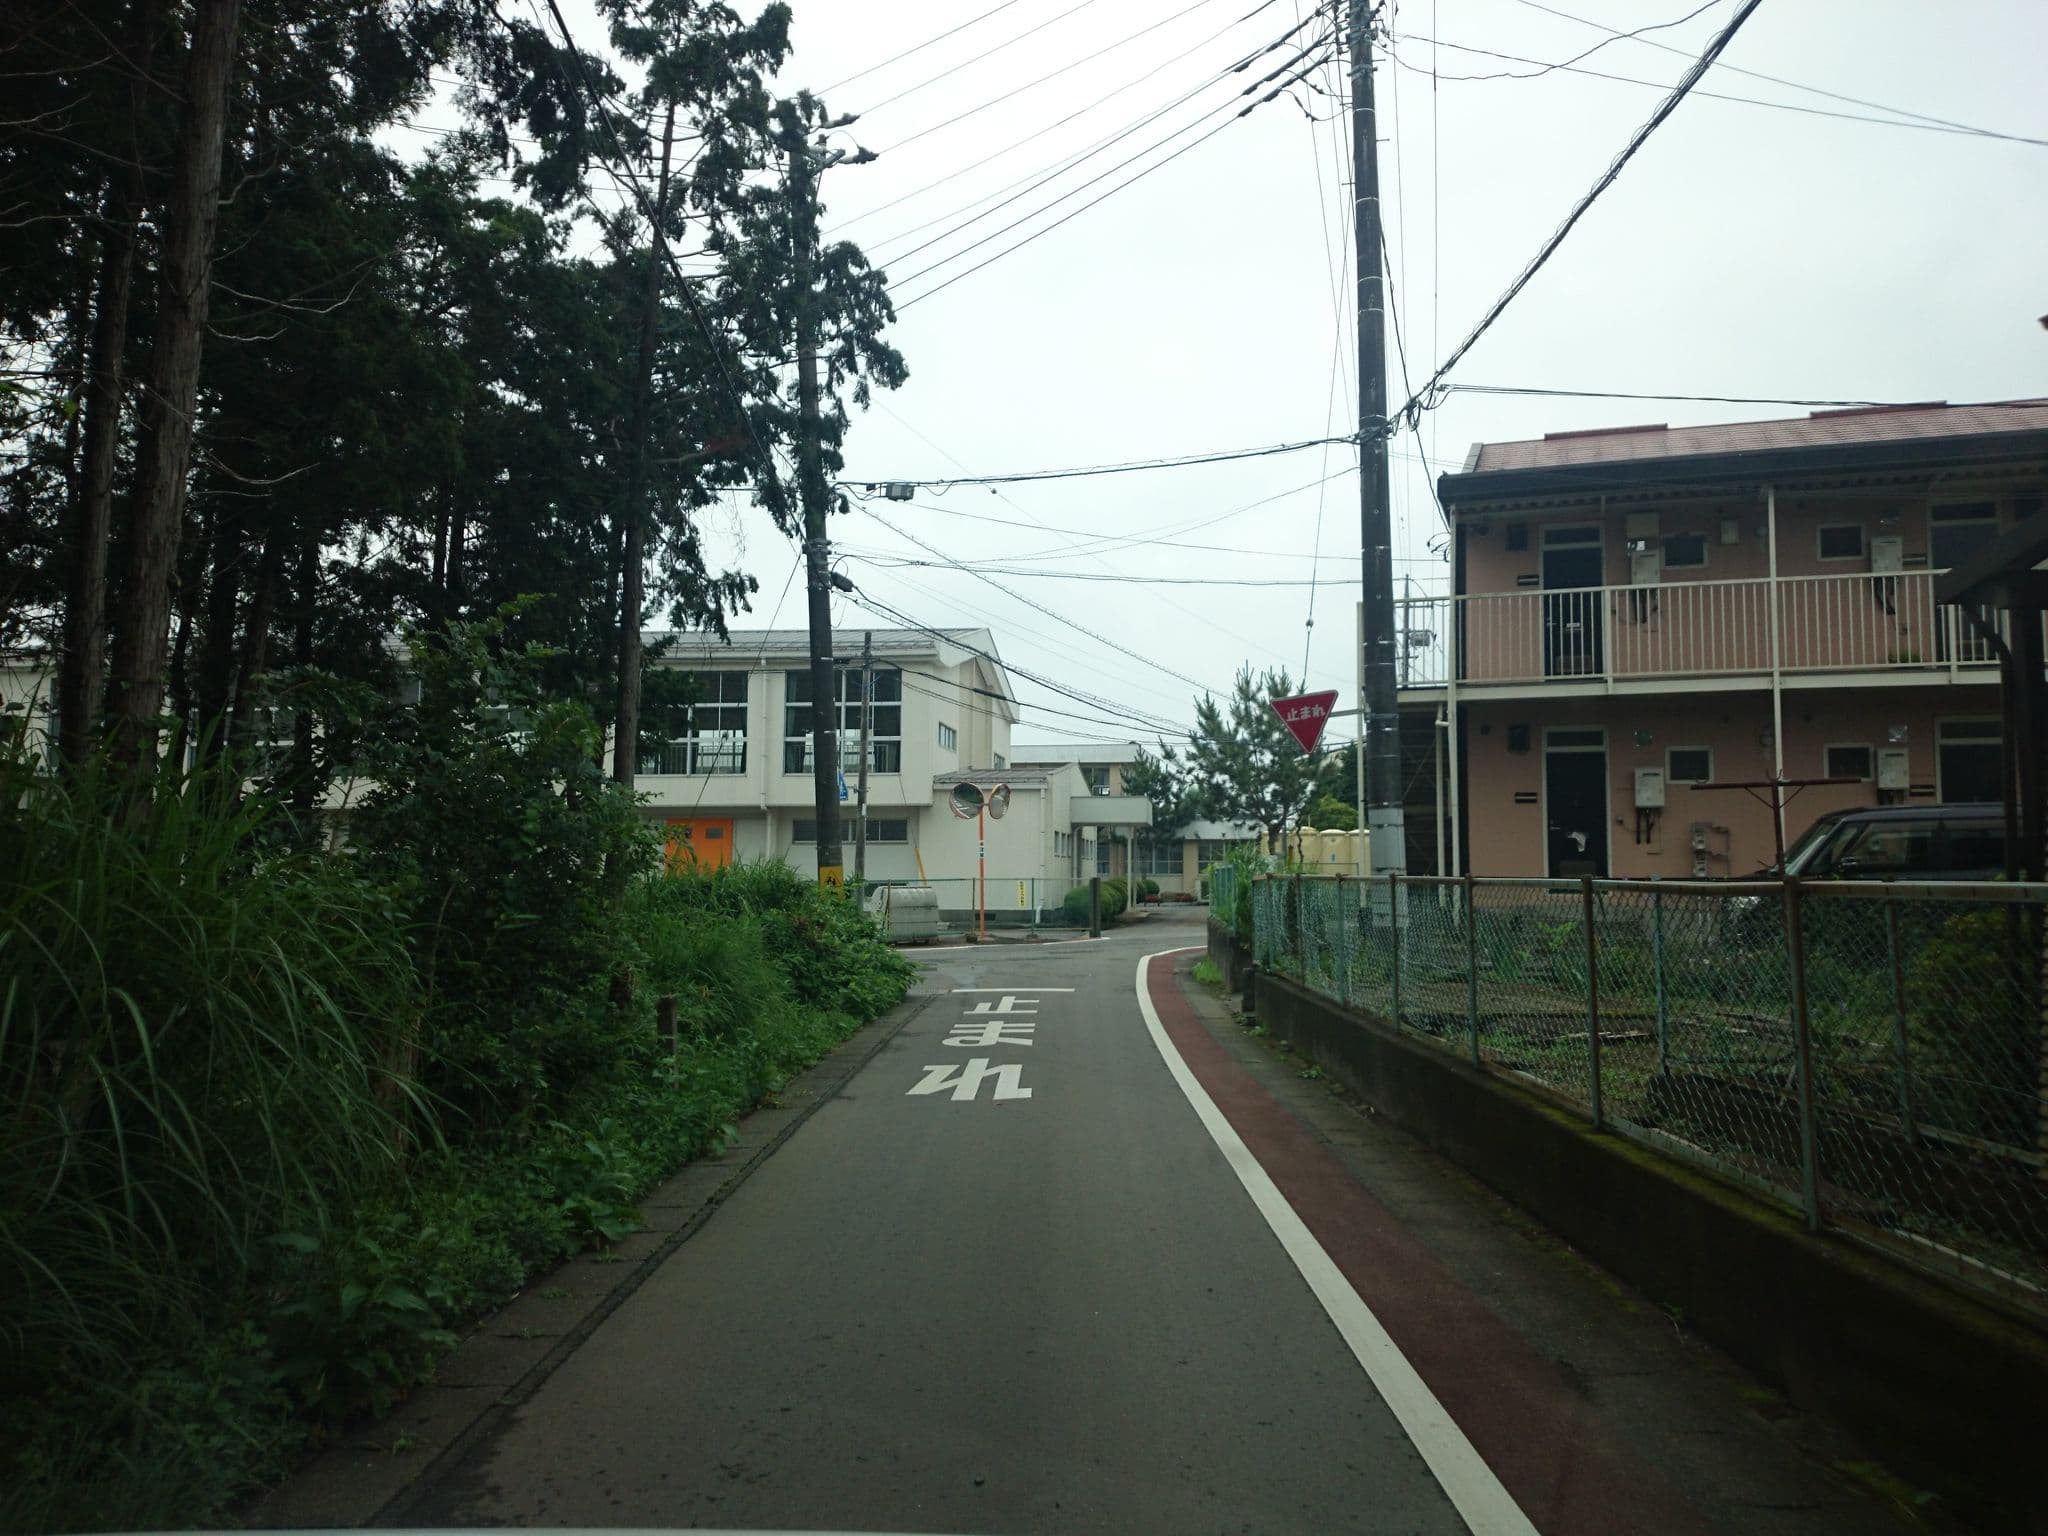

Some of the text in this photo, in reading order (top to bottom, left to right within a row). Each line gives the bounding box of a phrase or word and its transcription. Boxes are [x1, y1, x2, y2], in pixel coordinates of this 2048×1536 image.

[1286, 704, 1326, 721] 止まれ
[905, 996, 1040, 1101] 止まれ
